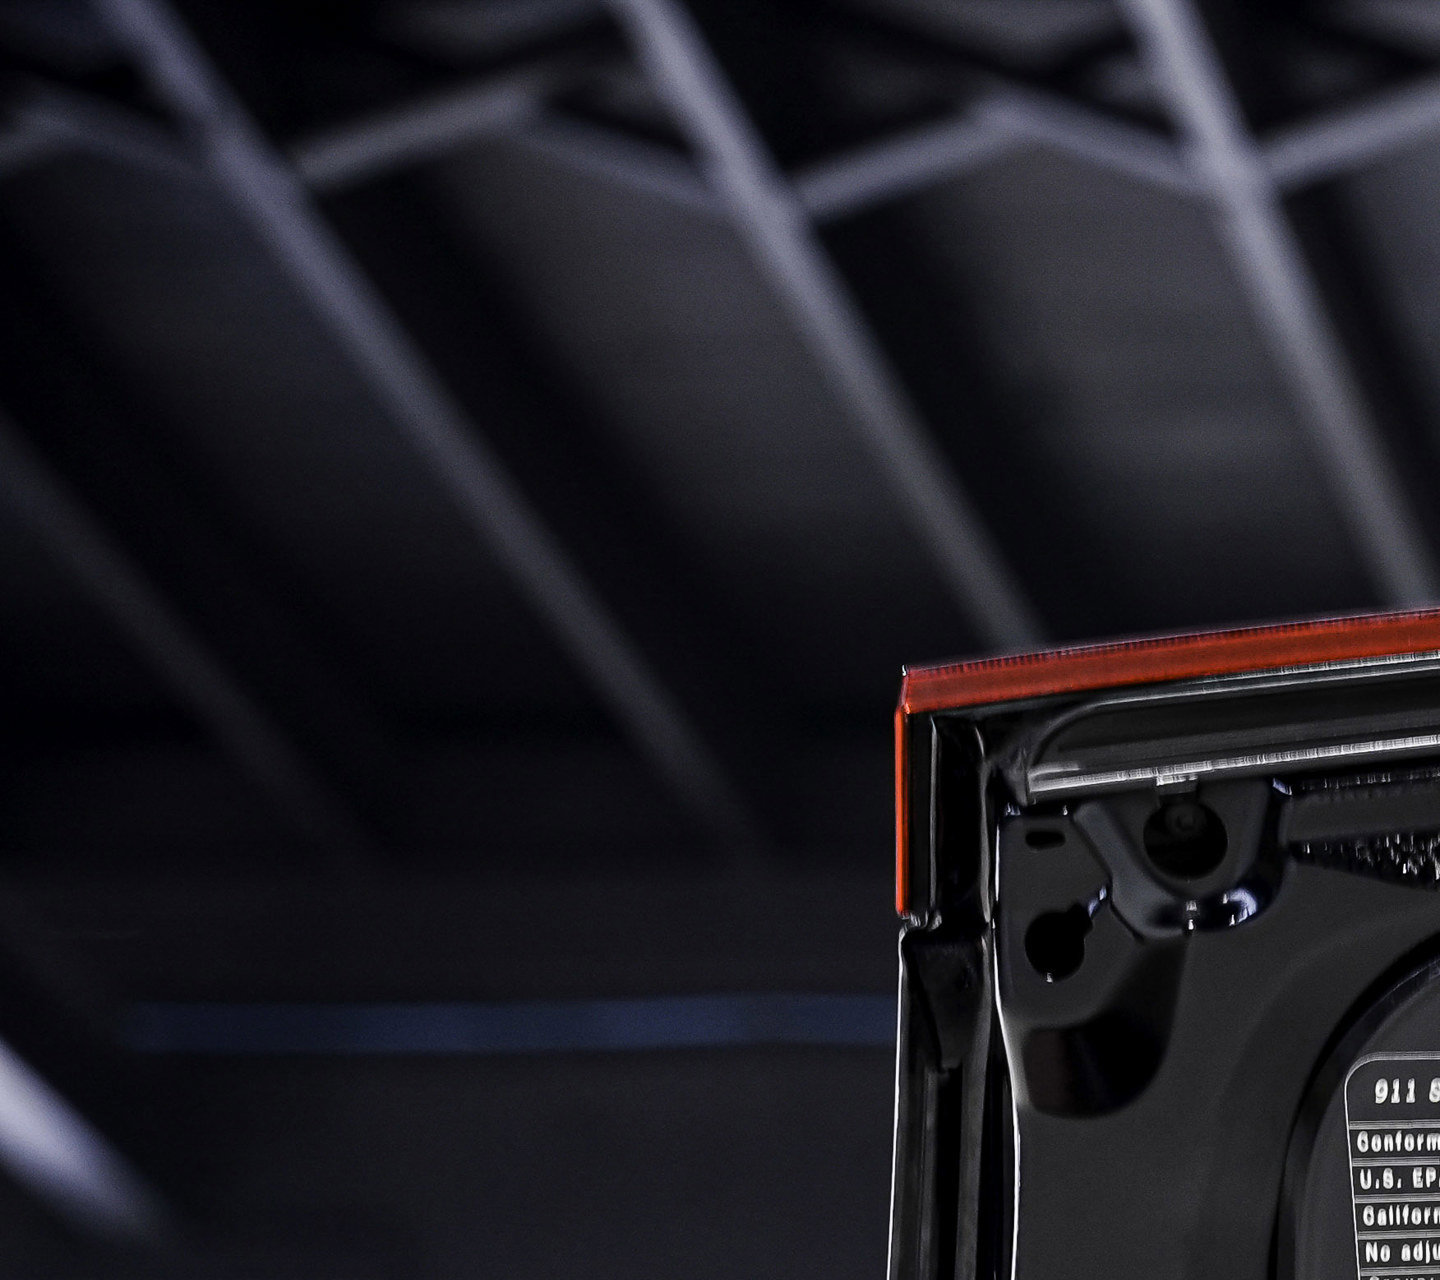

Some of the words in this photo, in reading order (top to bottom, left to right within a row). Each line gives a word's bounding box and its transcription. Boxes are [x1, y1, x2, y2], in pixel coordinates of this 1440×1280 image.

[1374, 1077, 1416, 1104] 911
[1359, 1167, 1402, 1190] U.S.
[1365, 1241, 1391, 1262] No
